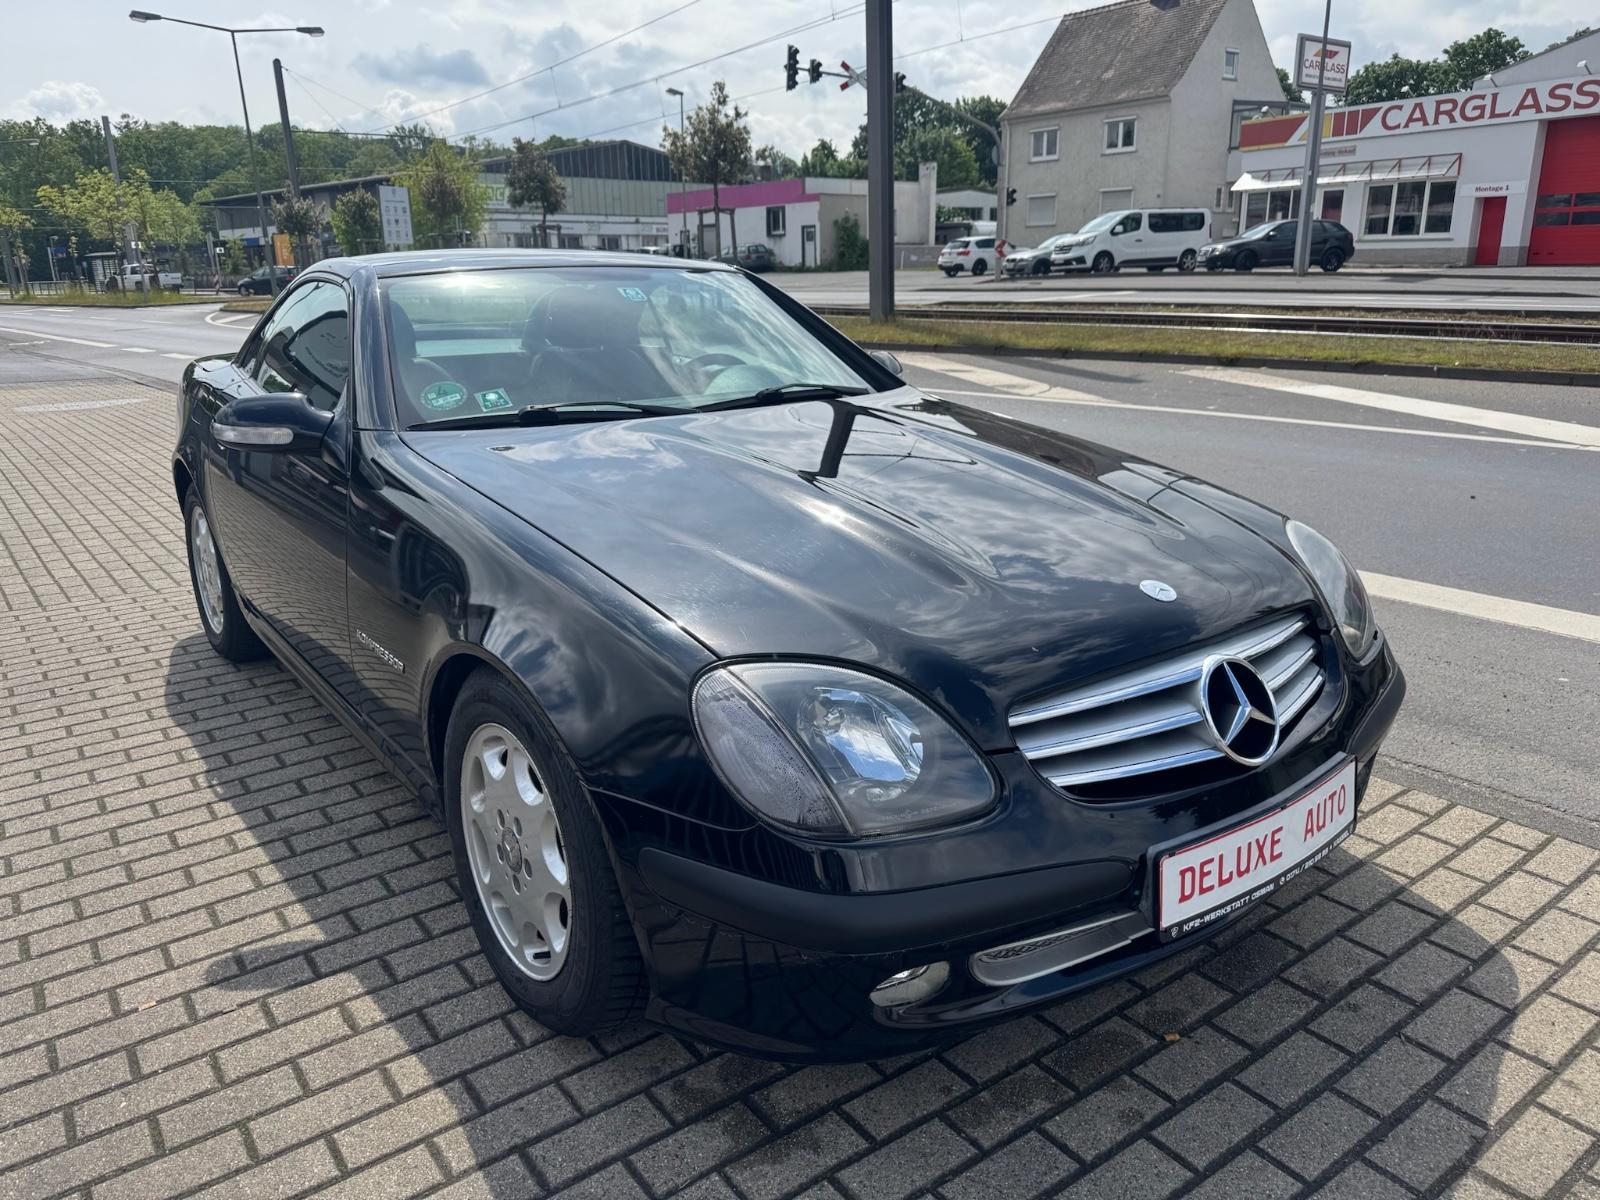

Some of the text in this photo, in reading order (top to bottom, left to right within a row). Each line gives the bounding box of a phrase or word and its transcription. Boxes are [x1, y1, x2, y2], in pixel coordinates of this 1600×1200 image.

[1303, 58, 1346, 74] CARLASS
[1381, 78, 1600, 132] CARGLASS
[1475, 185, 1504, 193] Montage
[1178, 784, 1347, 904] DELUXE AUTO
[1182, 895, 1251, 933] KFZ-WERKSTATT
